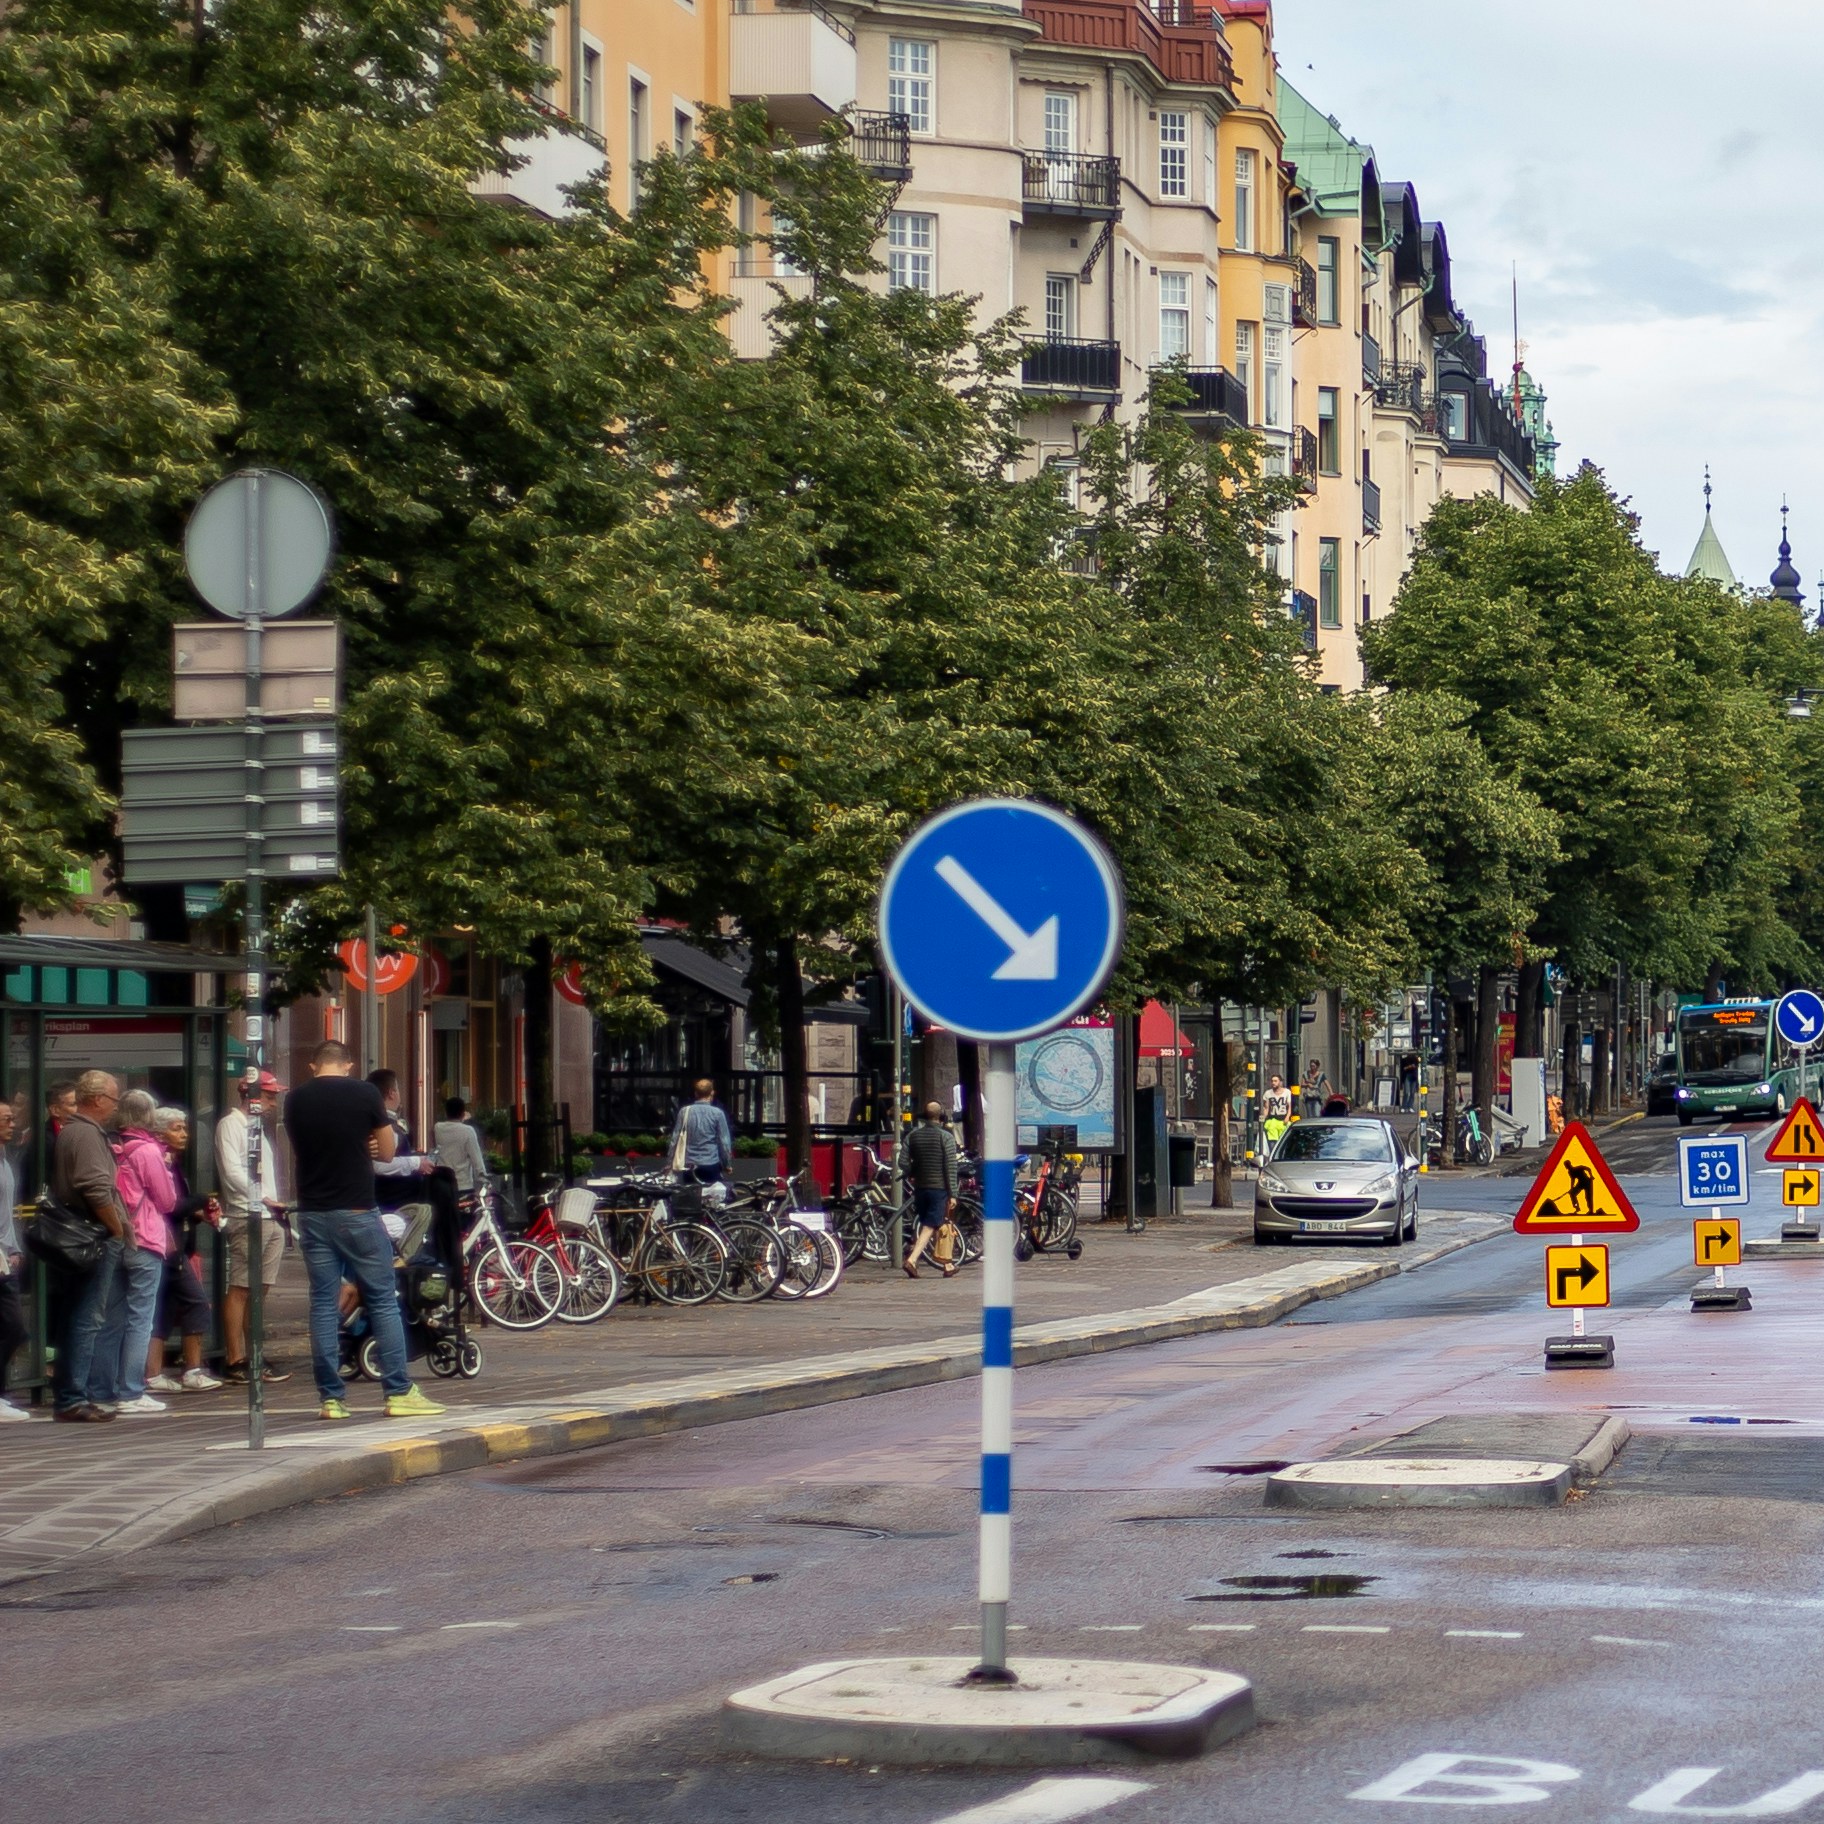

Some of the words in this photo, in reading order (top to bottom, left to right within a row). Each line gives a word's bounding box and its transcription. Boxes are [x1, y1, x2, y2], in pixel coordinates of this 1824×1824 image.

[1700, 1150, 1725, 1159] max
[1697, 1161, 1731, 1181] 30
[1693, 1184, 1737, 1194] km/tim
